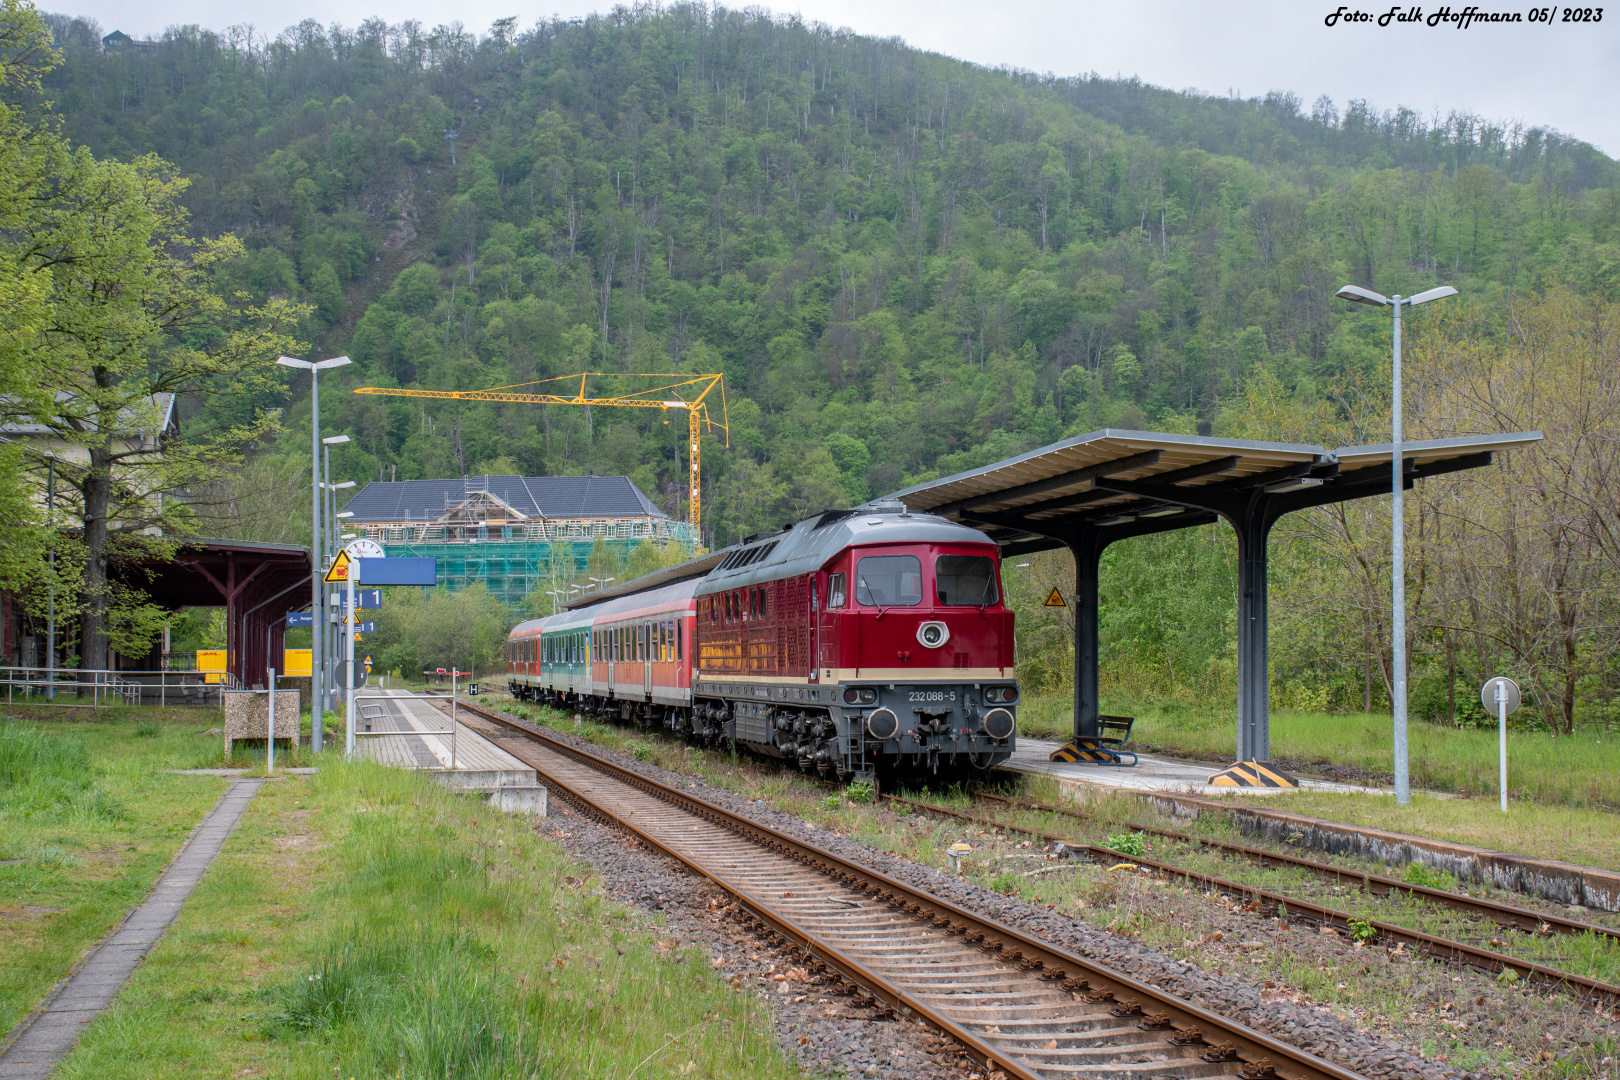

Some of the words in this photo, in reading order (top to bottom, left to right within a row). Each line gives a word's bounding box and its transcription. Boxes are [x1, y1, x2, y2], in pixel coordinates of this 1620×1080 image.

[372, 590, 380, 604] 1
[369, 622, 374, 631] 1
[470, 684, 478, 694] H
[908, 692, 926, 702] 232
[926, 692, 956, 701] 088-5
